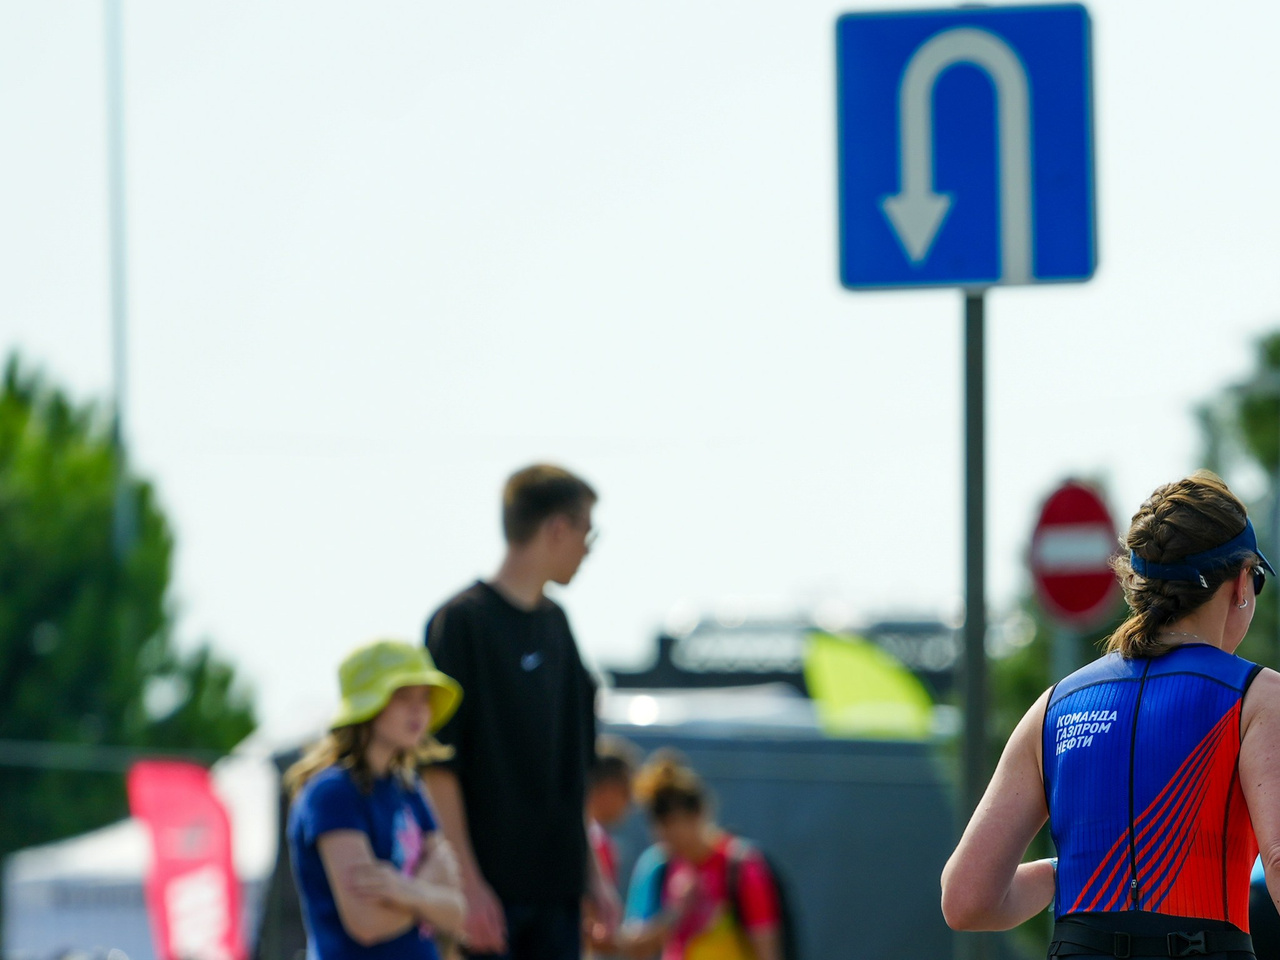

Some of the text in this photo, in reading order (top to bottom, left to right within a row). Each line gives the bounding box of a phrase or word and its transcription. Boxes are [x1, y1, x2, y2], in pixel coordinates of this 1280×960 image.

[1056, 711, 1118, 728] КОМАНДА
[1056, 722, 1112, 742] ГАЗПРОМ
[1056, 735, 1094, 756] НЕФТИ
